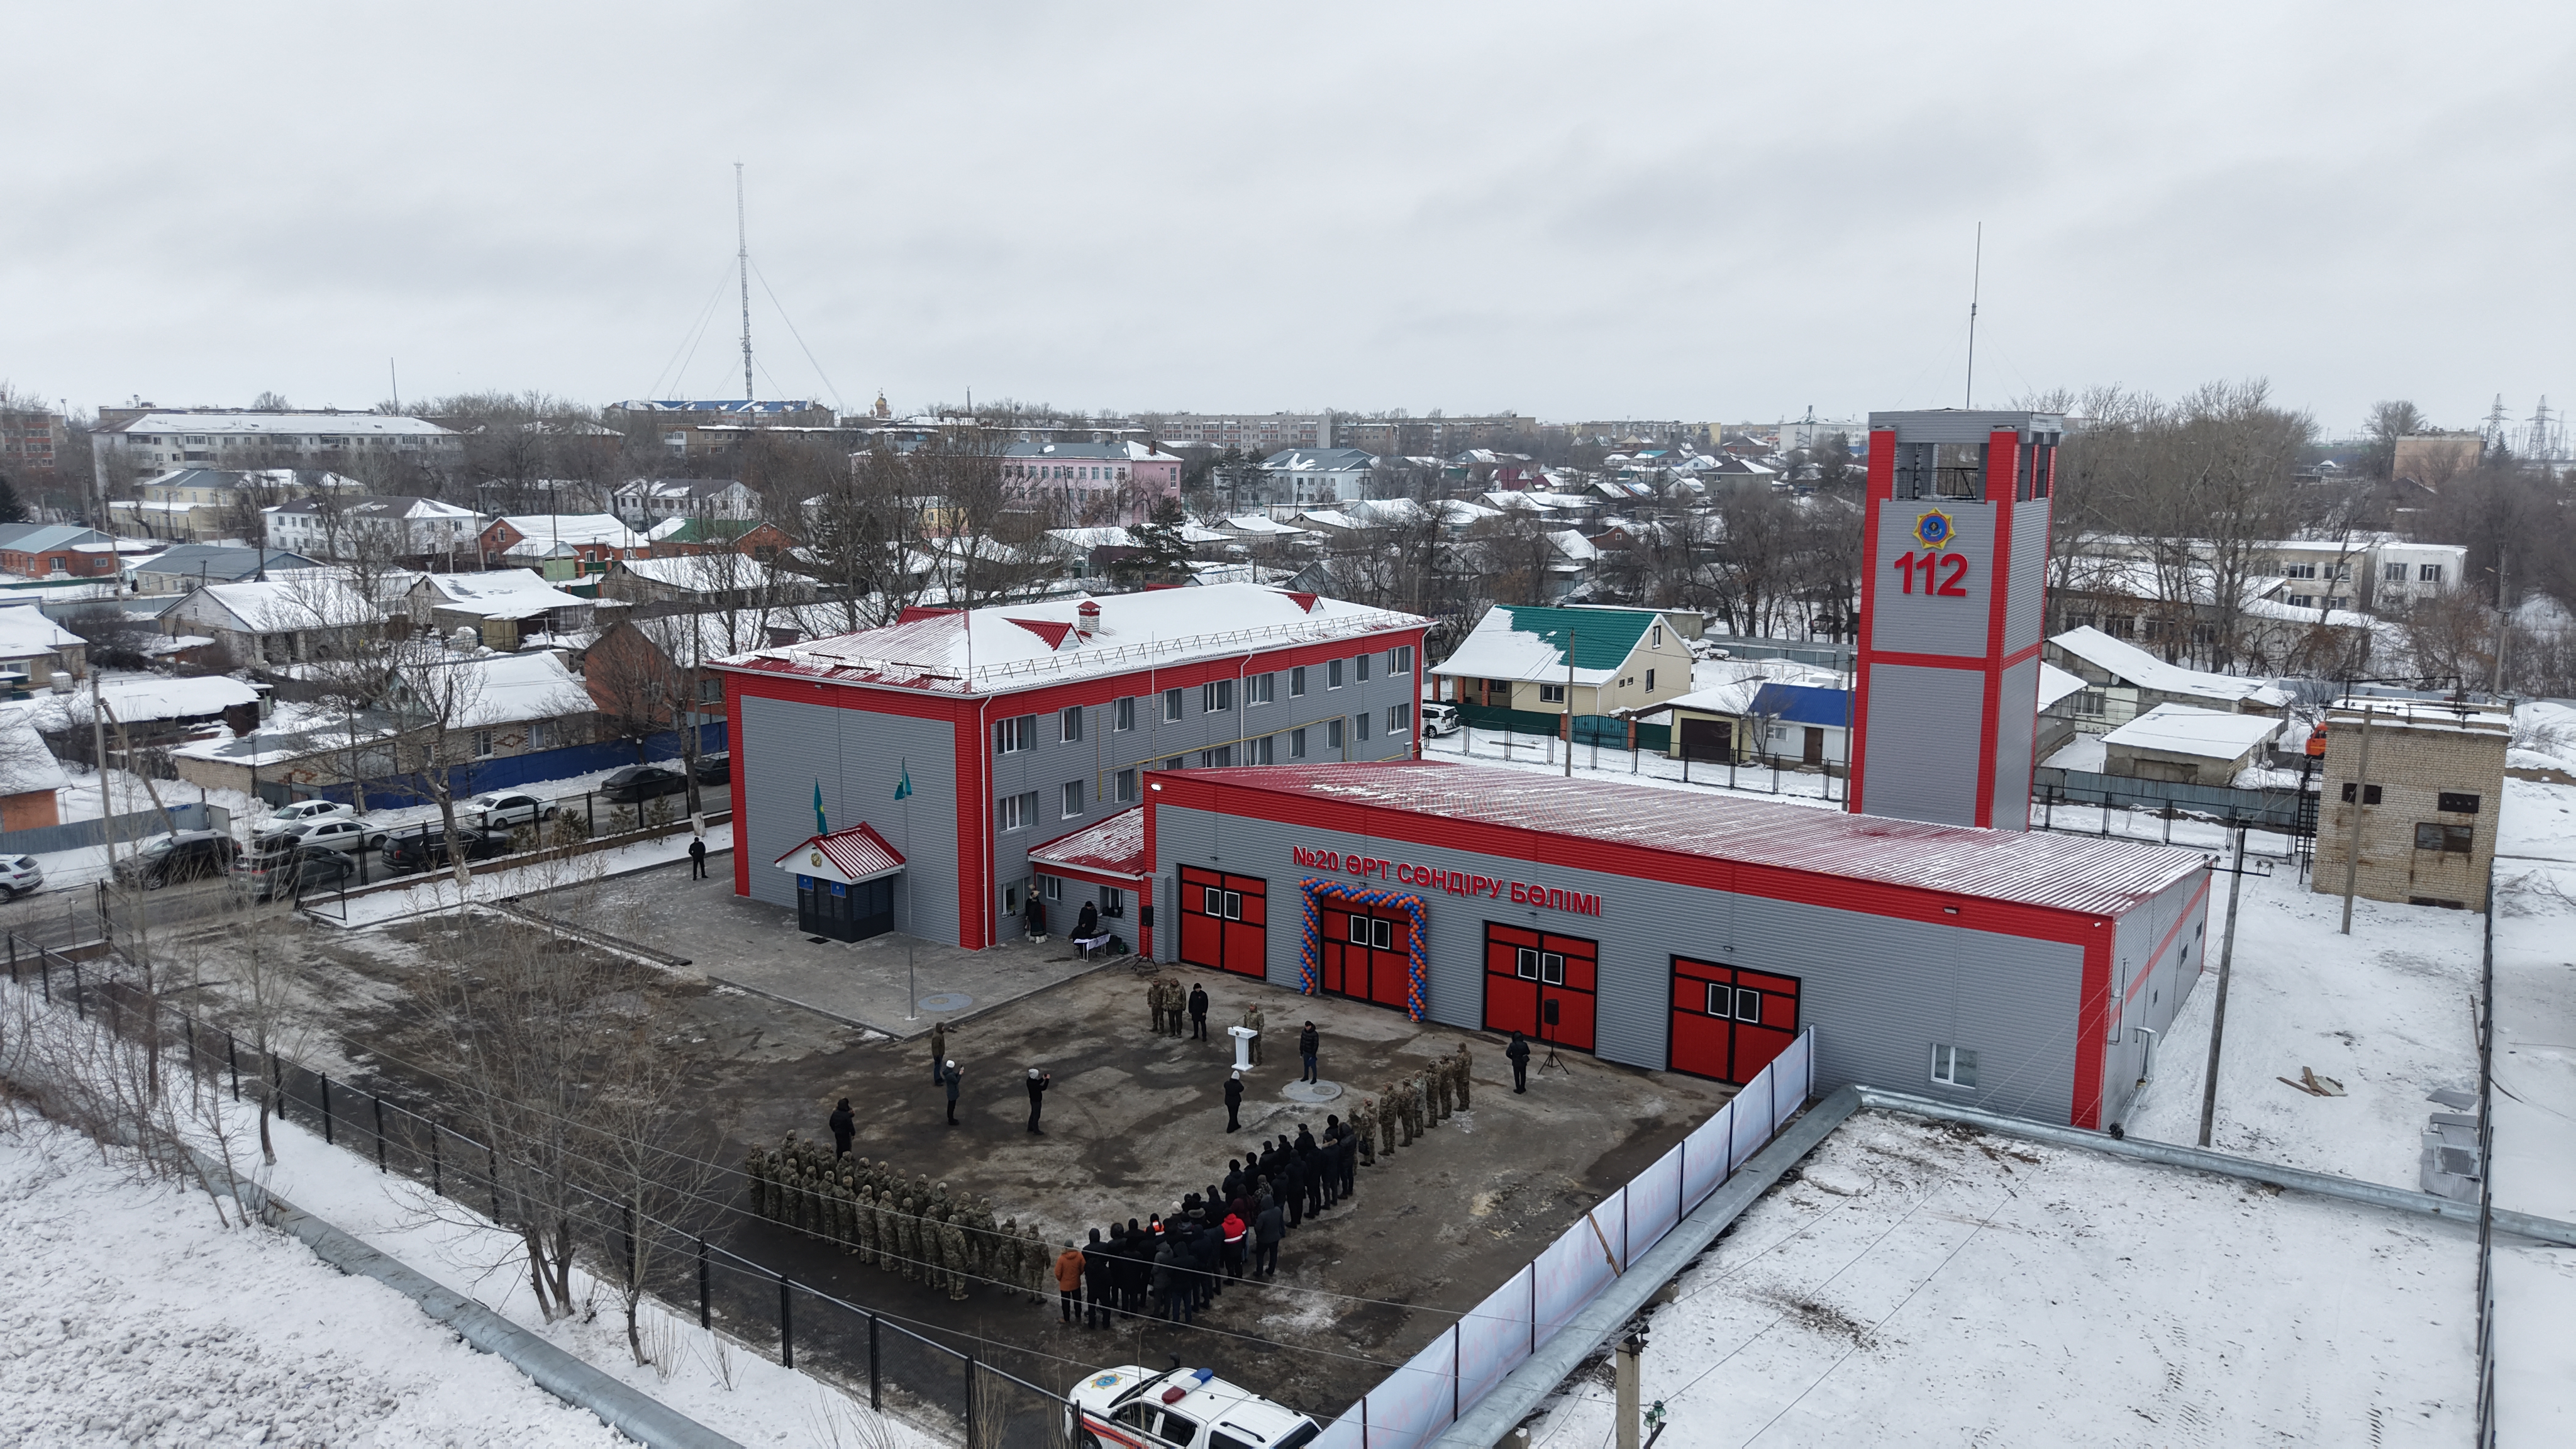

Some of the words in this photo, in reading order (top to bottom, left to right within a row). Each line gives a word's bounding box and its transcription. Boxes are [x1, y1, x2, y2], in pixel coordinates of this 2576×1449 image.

[1894, 551, 1968, 597] 112
[1293, 845, 1340, 871] №20
[1345, 853, 1392, 880] ӨРТ
[1397, 862, 1504, 899] СӨНДІРУ
[1510, 881, 1602, 917] БӨЛІМІ
